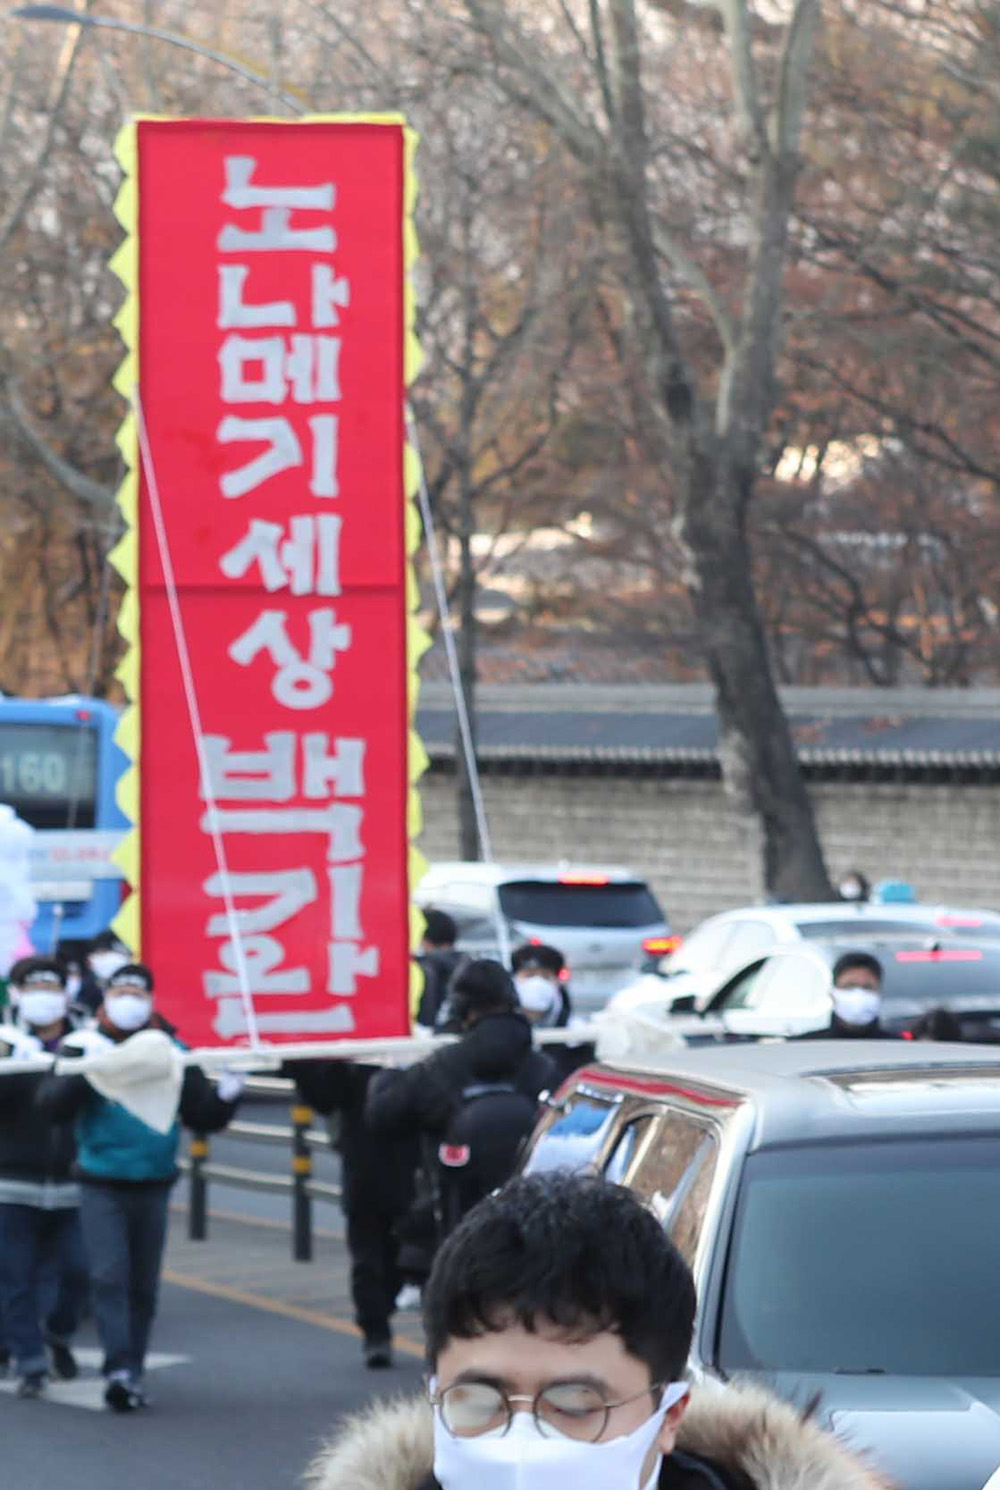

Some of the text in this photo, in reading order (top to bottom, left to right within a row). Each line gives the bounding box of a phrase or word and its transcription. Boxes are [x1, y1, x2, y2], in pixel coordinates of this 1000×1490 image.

[200, 155, 380, 1039] 노나메기 세상 백기완
